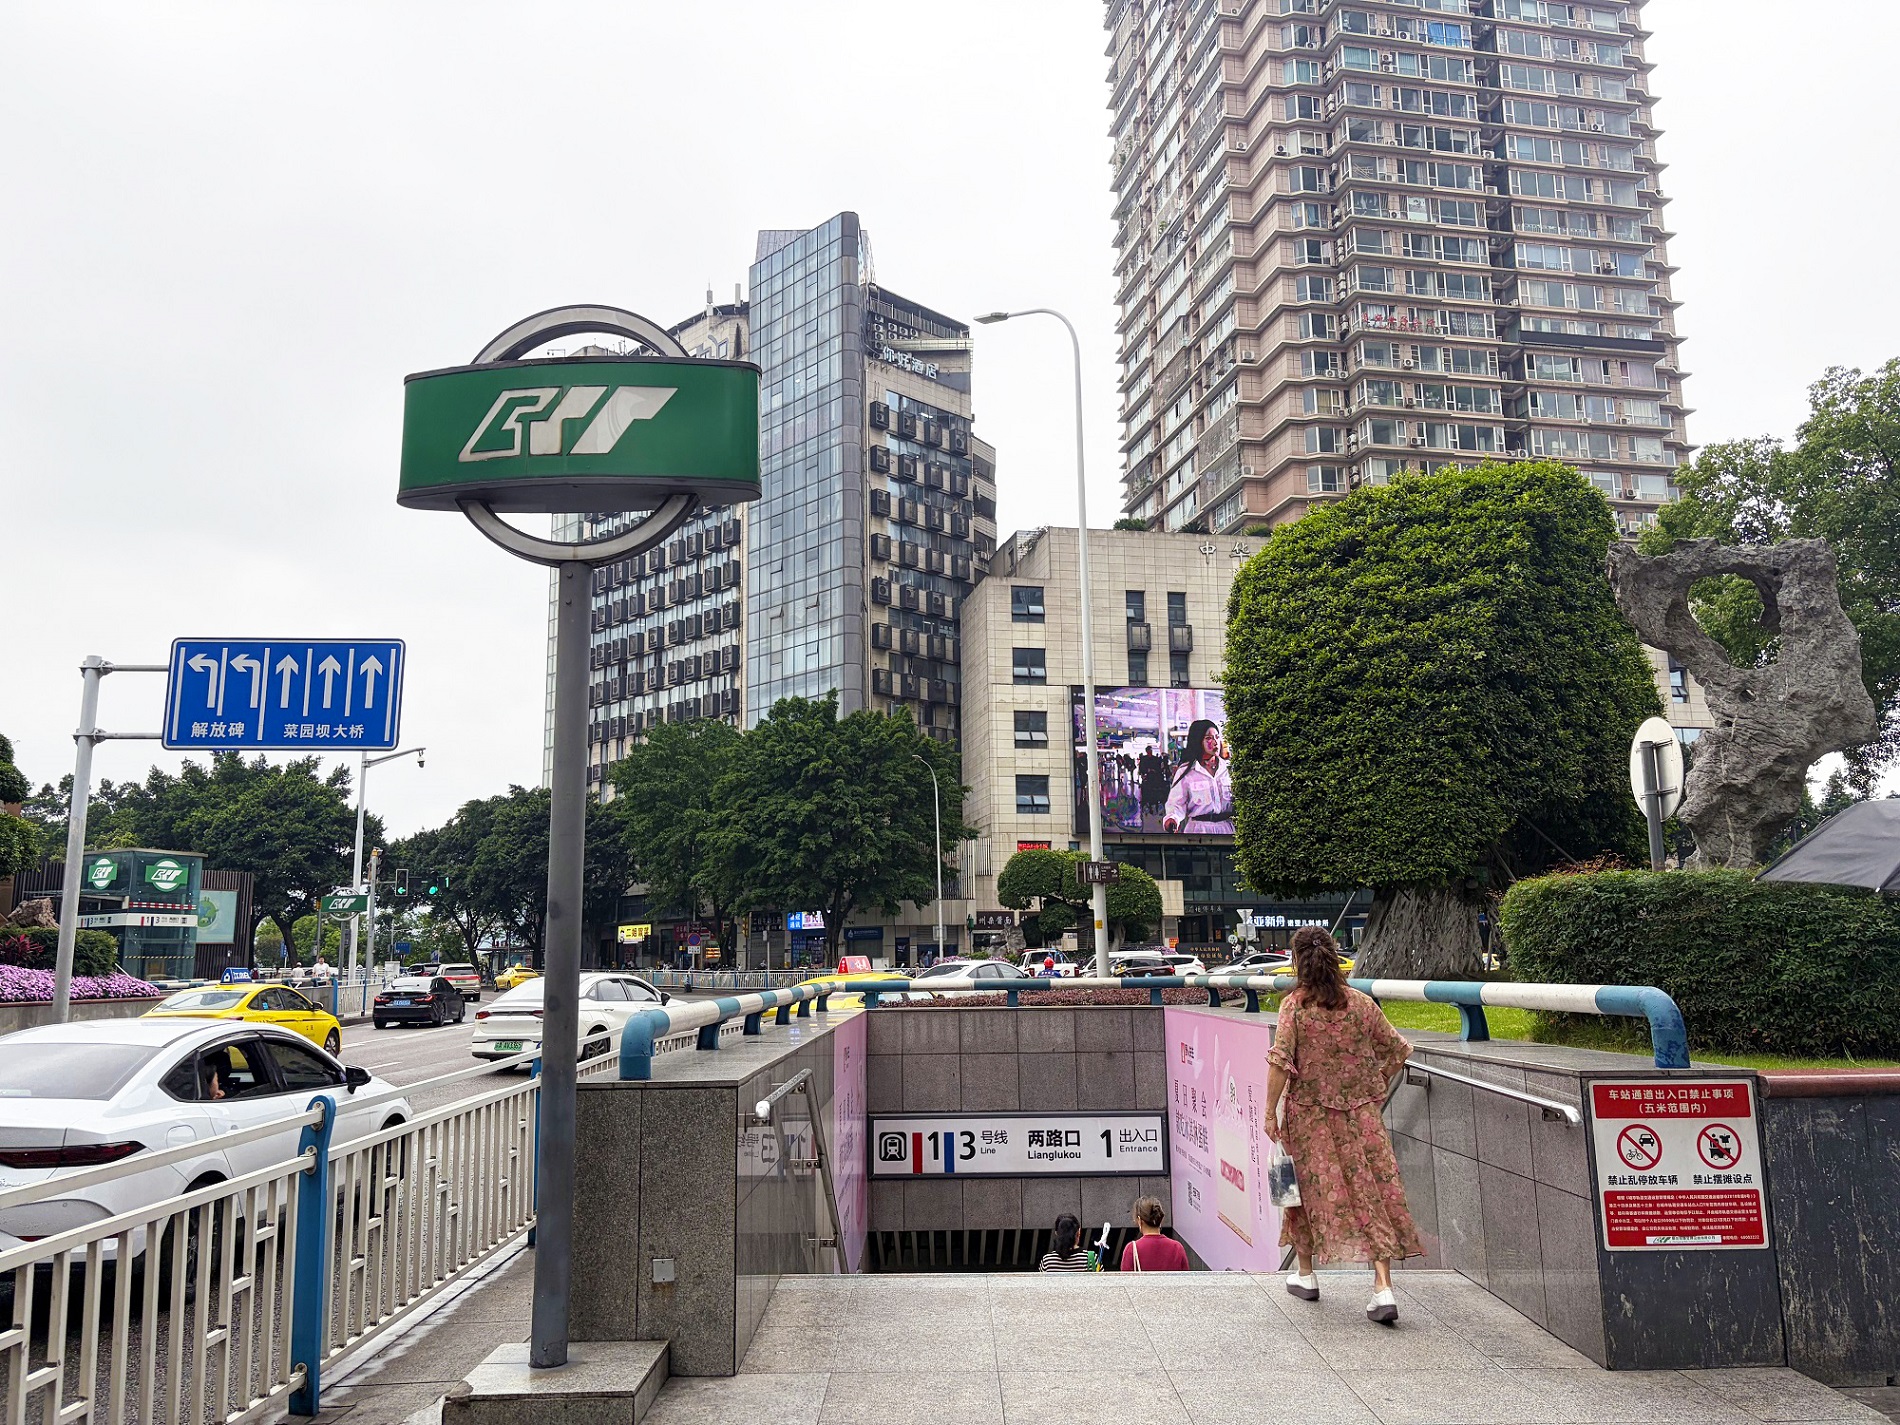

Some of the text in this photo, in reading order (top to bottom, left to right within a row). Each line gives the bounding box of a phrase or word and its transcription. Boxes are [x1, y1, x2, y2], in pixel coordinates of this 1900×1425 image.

[883, 345, 938, 380] 你好酒店
[190, 721, 245, 739] 解放碑
[283, 723, 365, 739] 菜园坝大桥
[1608, 1088, 1734, 1100] 车站通道出入口禁止事项
[928, 1130, 1008, 1161] 1 3 号线
[1027, 1130, 1081, 1148] 两路口
[1100, 1129, 1158, 1158] 1 出入口
[1027, 1150, 1081, 1161] Lianglukou
[1119, 1145, 1158, 1153] Entrance
[1608, 1174, 1753, 1186] 禁止乱停放车辆 禁止摆摊设点
